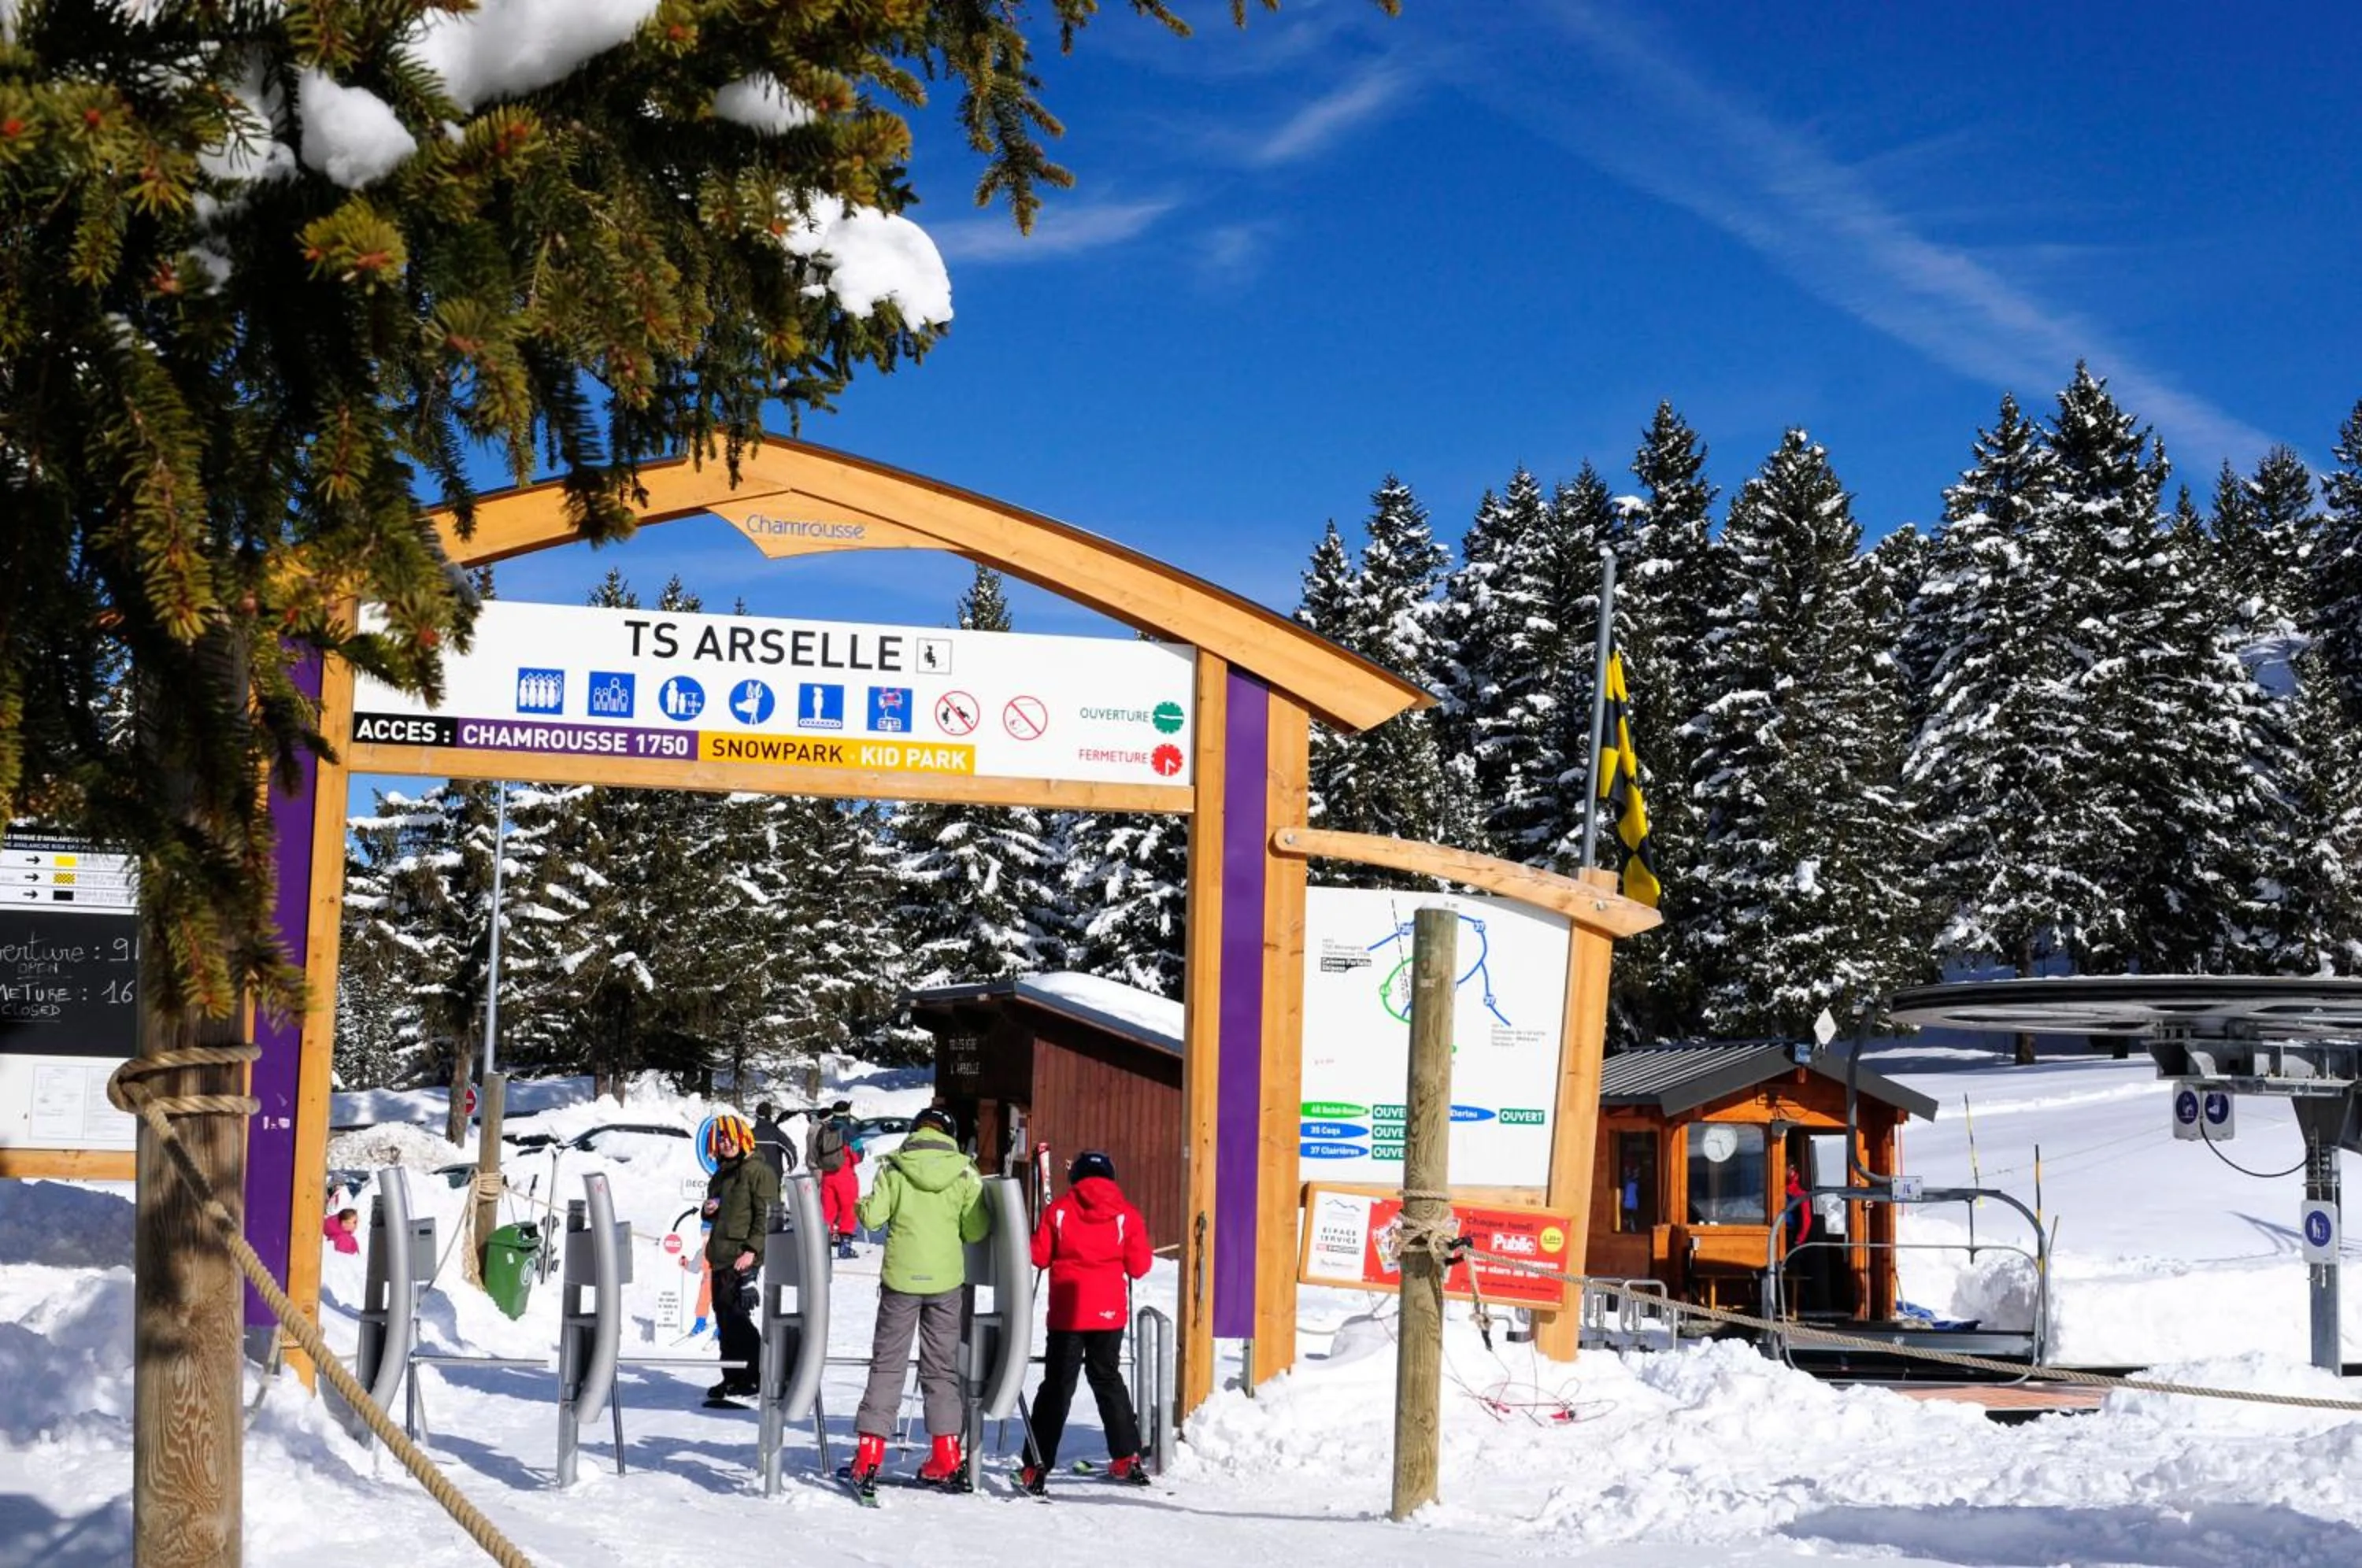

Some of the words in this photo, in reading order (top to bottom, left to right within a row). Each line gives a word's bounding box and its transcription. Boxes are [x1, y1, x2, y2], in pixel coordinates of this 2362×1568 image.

[746, 514, 865, 539] Chamrousse
[624, 619, 679, 659] TS
[693, 625, 903, 671] ARSELLE
[1079, 708, 1150, 723] OUVERTURE
[357, 719, 436, 742] ACCES
[462, 725, 628, 753] CHAMROUSSE
[635, 734, 689, 756] 1750
[712, 738, 844, 764] SNOWPARK
[861, 746, 900, 767] KID
[906, 748, 968, 771] PARK
[1079, 749, 1149, 764] FERMETURE
[0, 931, 85, 963] erture
[1374, 1108, 1407, 1118] OUVE
[1501, 1111, 1544, 1122] OUVERT
[1374, 1127, 1405, 1138] OUVE
[1374, 1147, 1405, 1158] OUVE
[1492, 1233, 1535, 1255] Public
